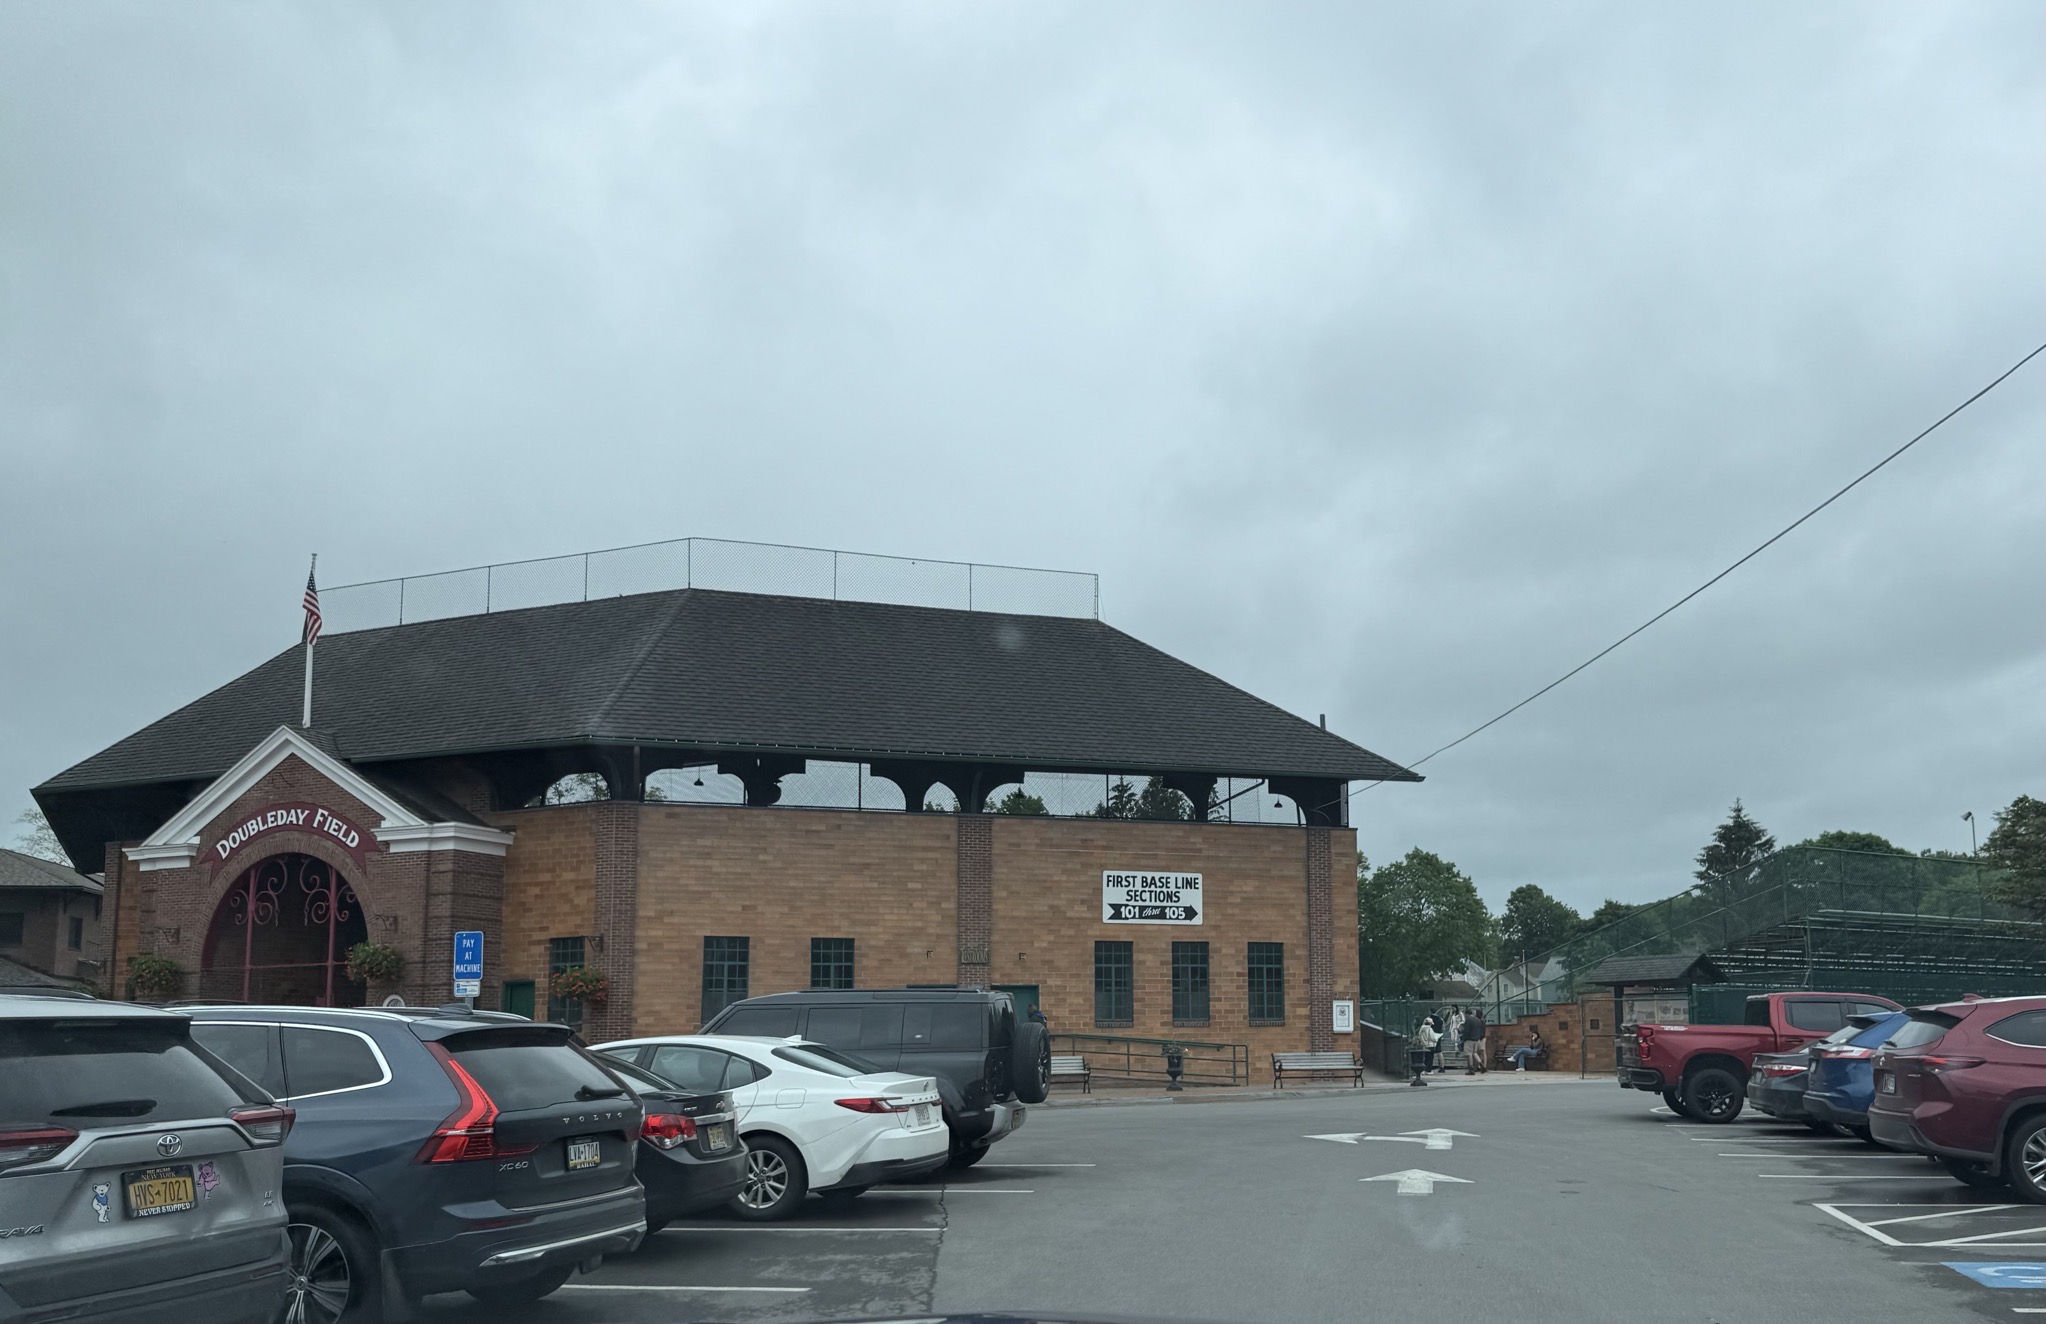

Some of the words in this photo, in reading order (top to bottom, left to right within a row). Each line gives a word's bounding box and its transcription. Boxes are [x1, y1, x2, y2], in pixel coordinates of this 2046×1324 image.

[216, 809, 310, 860] DOUBLEDAY
[313, 808, 360, 848] FIELD
[1106, 875, 1137, 888] FIRST
[1141, 876, 1171, 889] BASE
[1175, 876, 1200, 890] LINE
[1125, 889, 1181, 903] SECTIONS
[1120, 905, 1140, 919] 101
[1164, 906, 1186, 920] 105
[462, 939, 475, 948] PAY
[464, 951, 473, 961] AT
[455, 963, 481, 973] MACHINE
[562, 1112, 623, 1124] VOLVO
[499, 1161, 529, 1172] XC60
[138, 1206, 161, 1217] NEVER
[161, 1202, 191, 1213] STOPPED
